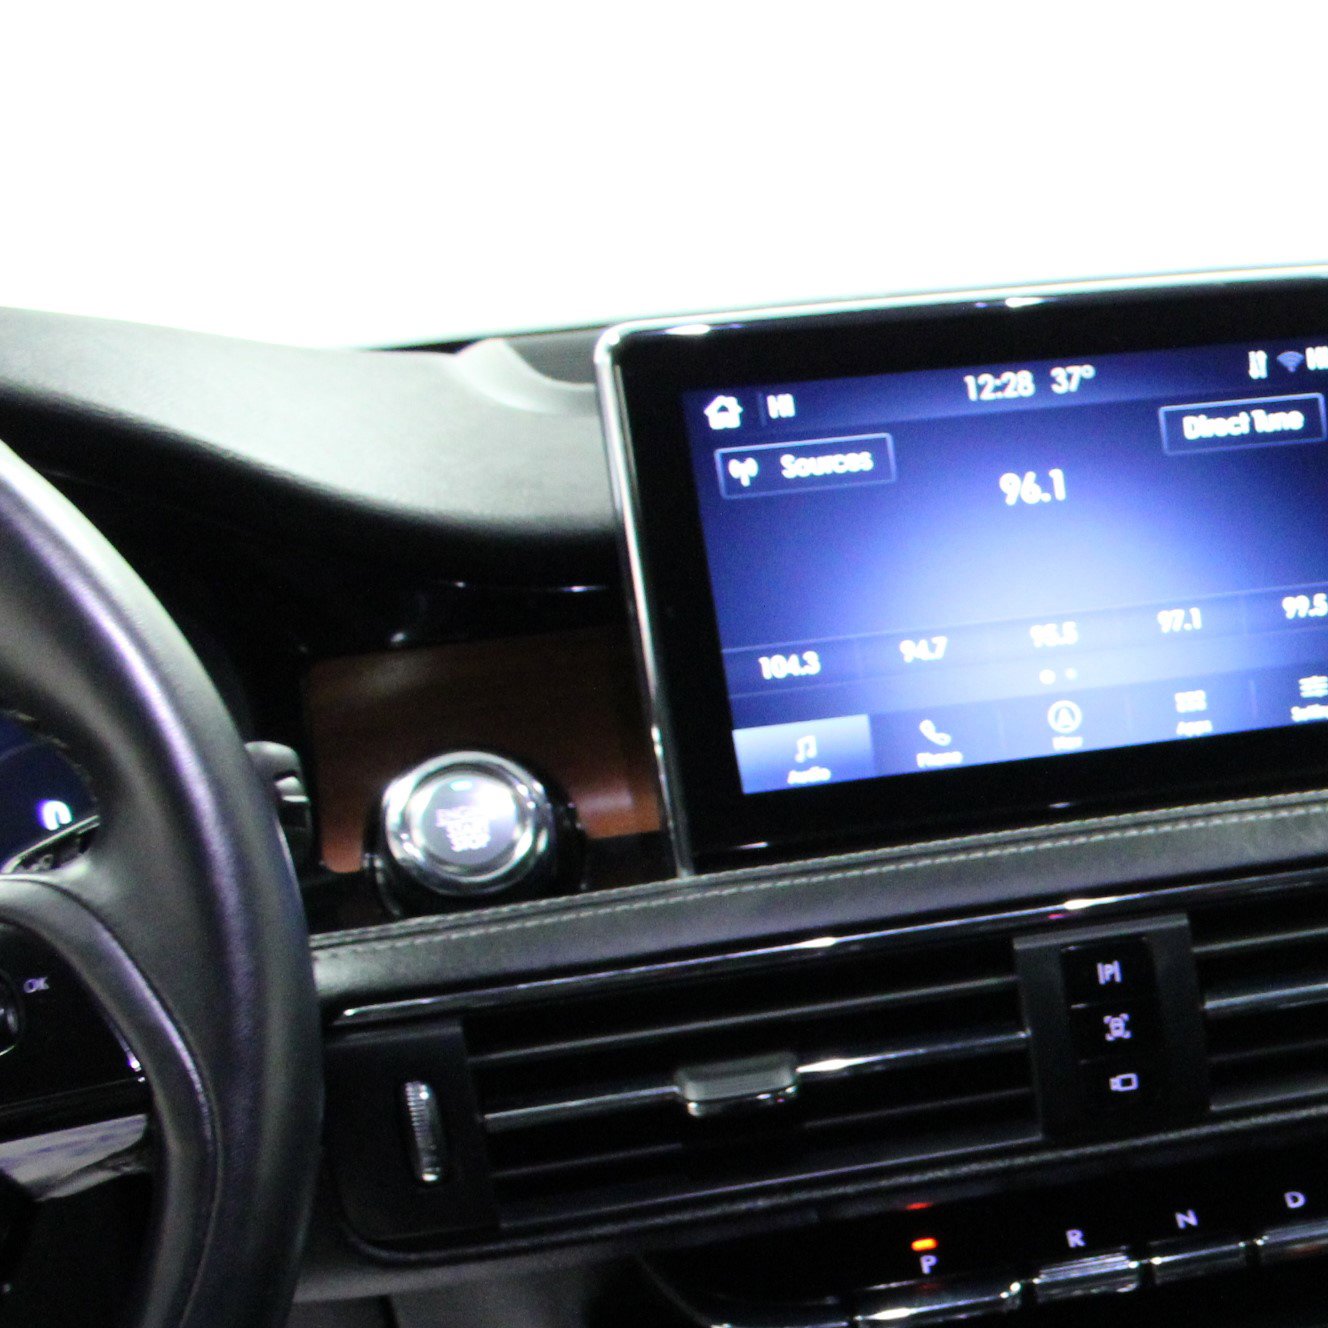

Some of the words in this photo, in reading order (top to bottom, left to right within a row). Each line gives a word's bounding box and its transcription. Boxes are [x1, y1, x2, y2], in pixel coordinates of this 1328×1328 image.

[963, 369, 1036, 401] 12:28
[1181, 410, 1250, 440] Direct
[1251, 408, 1305, 433] Tune
[779, 450, 874, 479] Sources
[998, 467, 1067, 506] 96.1
[1156, 606, 1203, 634] 97.1
[899, 635, 948, 663] 94.7
[758, 650, 821, 679] 104.3
[1284, 1191, 1307, 1209] D
[1175, 1209, 1199, 1229] N
[1065, 1229, 1086, 1249] R
[920, 1254, 939, 1275] P
